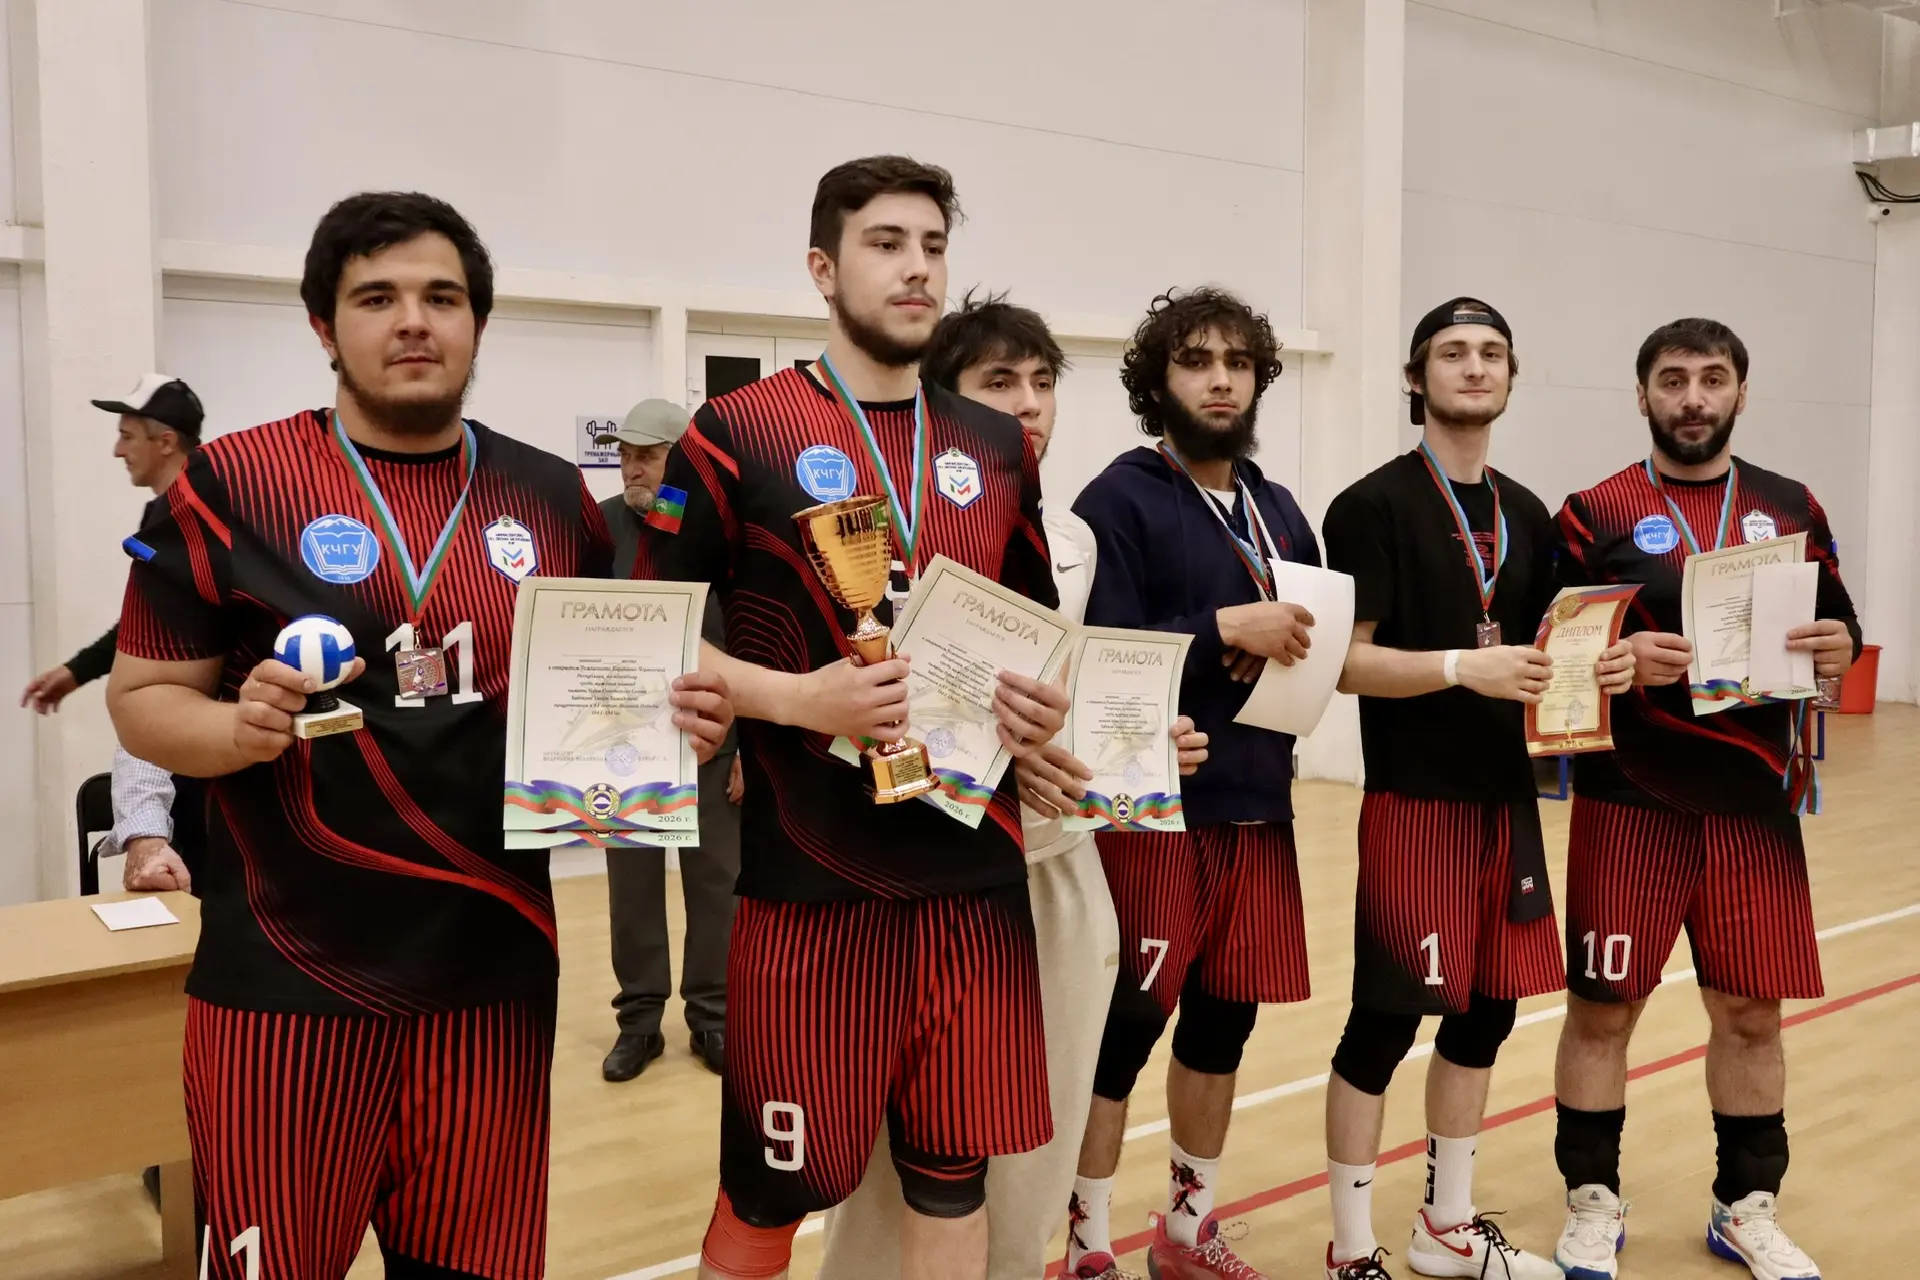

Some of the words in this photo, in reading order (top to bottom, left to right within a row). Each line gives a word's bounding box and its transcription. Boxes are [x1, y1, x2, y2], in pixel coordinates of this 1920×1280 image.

[813, 469, 842, 480] КЧГУ
[1645, 532, 1669, 540] КЧГУ
[321, 544, 360, 555] КЧГУ
[1711, 552, 1781, 577] ГРАМОТА
[561, 602, 668, 622] ГРАМОТА
[952, 591, 1039, 646] ГРАМОТА
[1556, 625, 1603, 638] ДИПЛОМ
[386, 621, 483, 707] 11
[1098, 648, 1162, 666] ГРАМОТА
[944, 801, 964, 815] 2026
[658, 815, 682, 823] 2026
[657, 834, 682, 842] 2026
[1140, 938, 1169, 991] 7
[1420, 932, 1444, 985] 1
[1583, 930, 1632, 981] 10
[763, 1101, 804, 1171] 9
